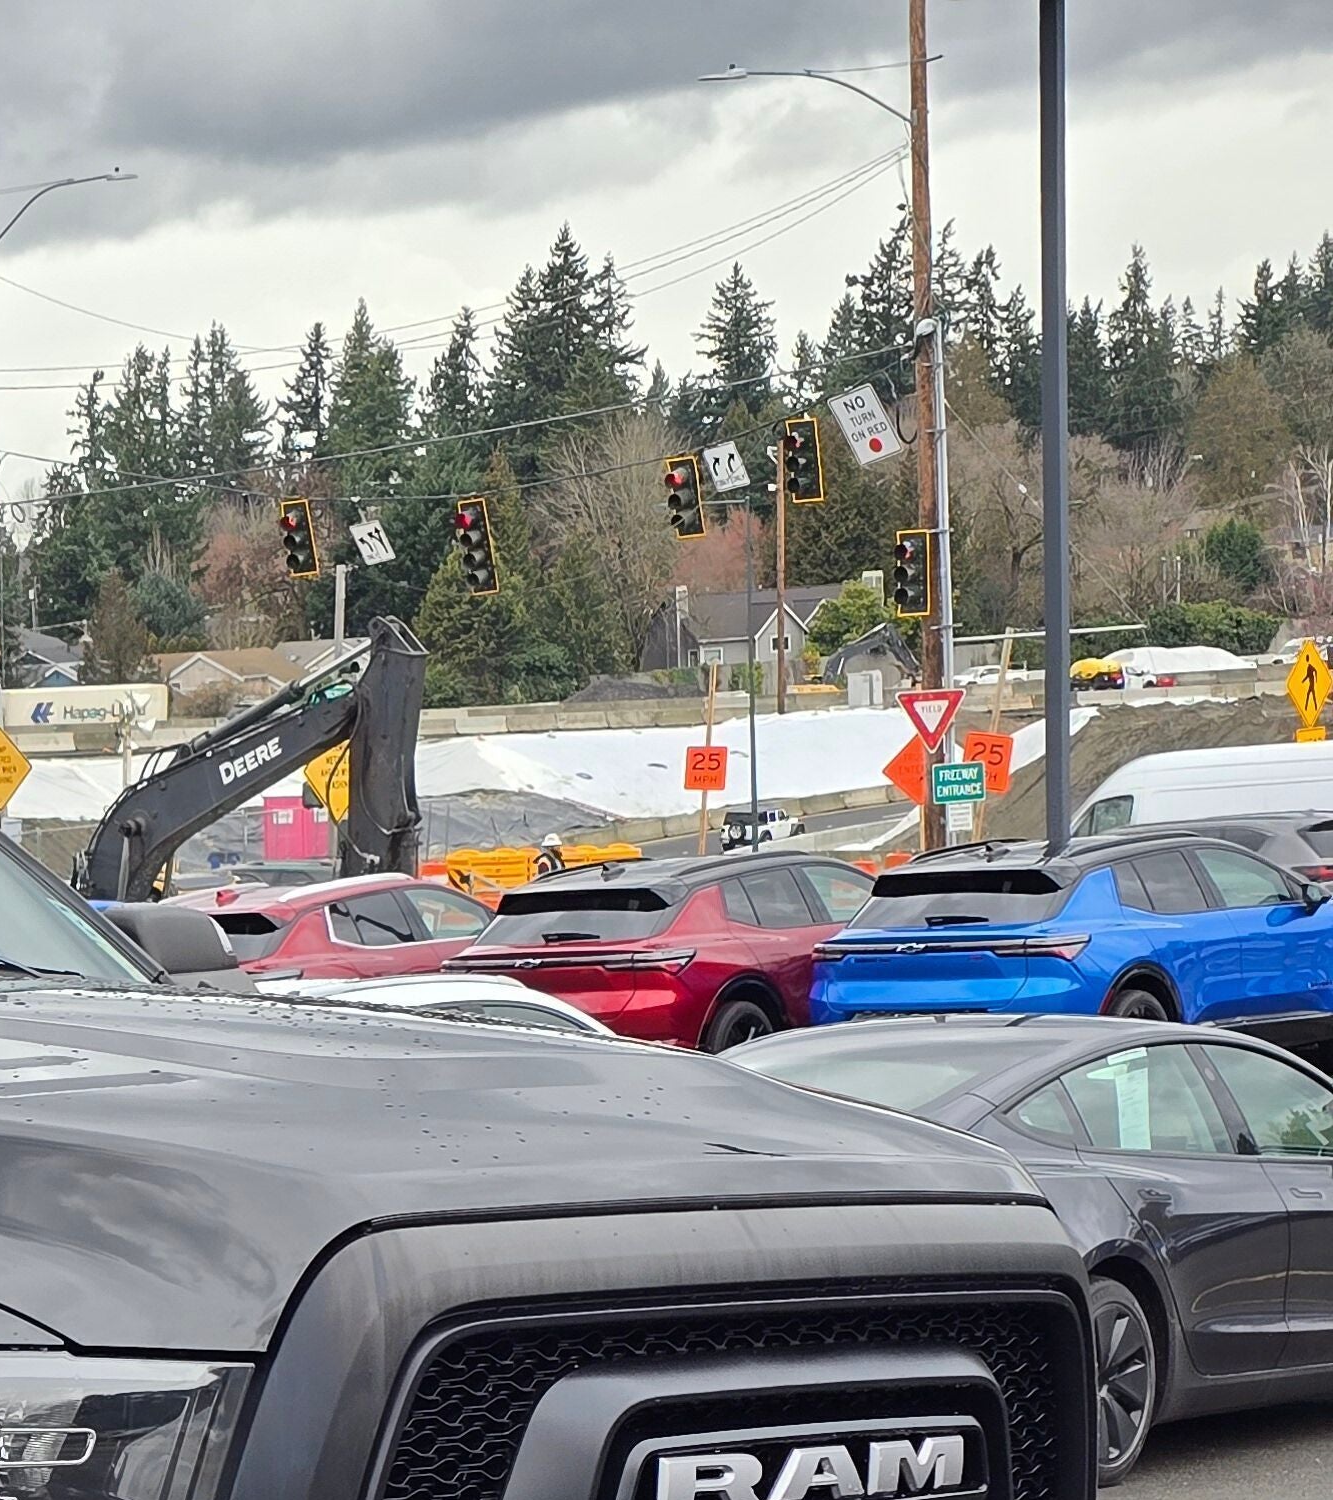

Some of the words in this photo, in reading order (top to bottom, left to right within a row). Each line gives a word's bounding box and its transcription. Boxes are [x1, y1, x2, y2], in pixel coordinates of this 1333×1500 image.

[842, 395, 866, 414] NO
[849, 410, 876, 428] TURN
[851, 432, 867, 443] ON
[867, 421, 888, 436] RED
[921, 706, 942, 714] YIELD
[218, 736, 283, 785] DEERE
[692, 753, 721, 771] 25
[971, 742, 1004, 766] 25
[2, 765, 17, 774] WHEN
[938, 767, 979, 781] FREEWAY
[693, 776, 717, 784] MPH
[937, 783, 982, 798] ENTRANCE
